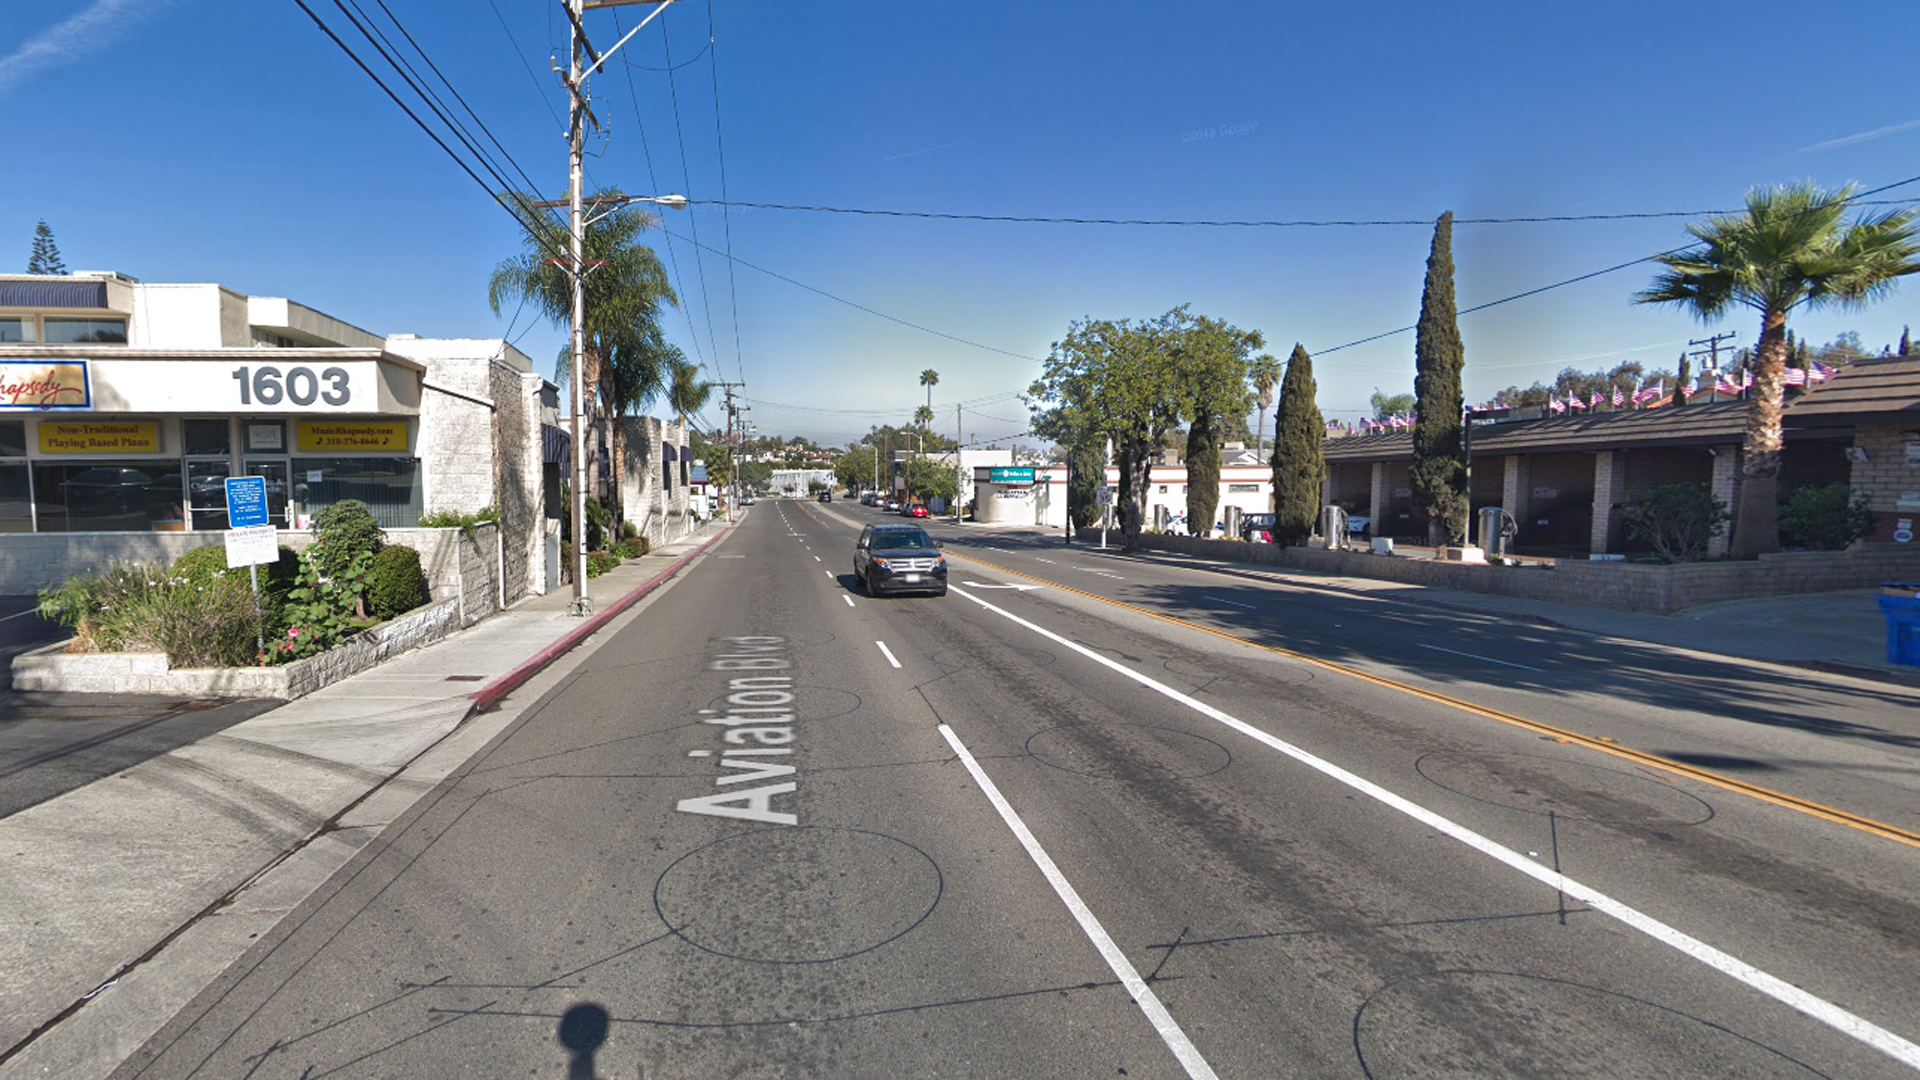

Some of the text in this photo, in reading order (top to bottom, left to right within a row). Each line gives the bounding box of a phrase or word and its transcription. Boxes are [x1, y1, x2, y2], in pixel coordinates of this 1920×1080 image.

[0, 369, 82, 410] hapsody
[232, 366, 351, 406] 1603
[57, 425, 138, 434] Non-Traditional
[311, 427, 393, 436] MusicRhapsody.com
[48, 438, 150, 448] Playing Based Piano
[676, 636, 798, 826] Aviation Blvd
